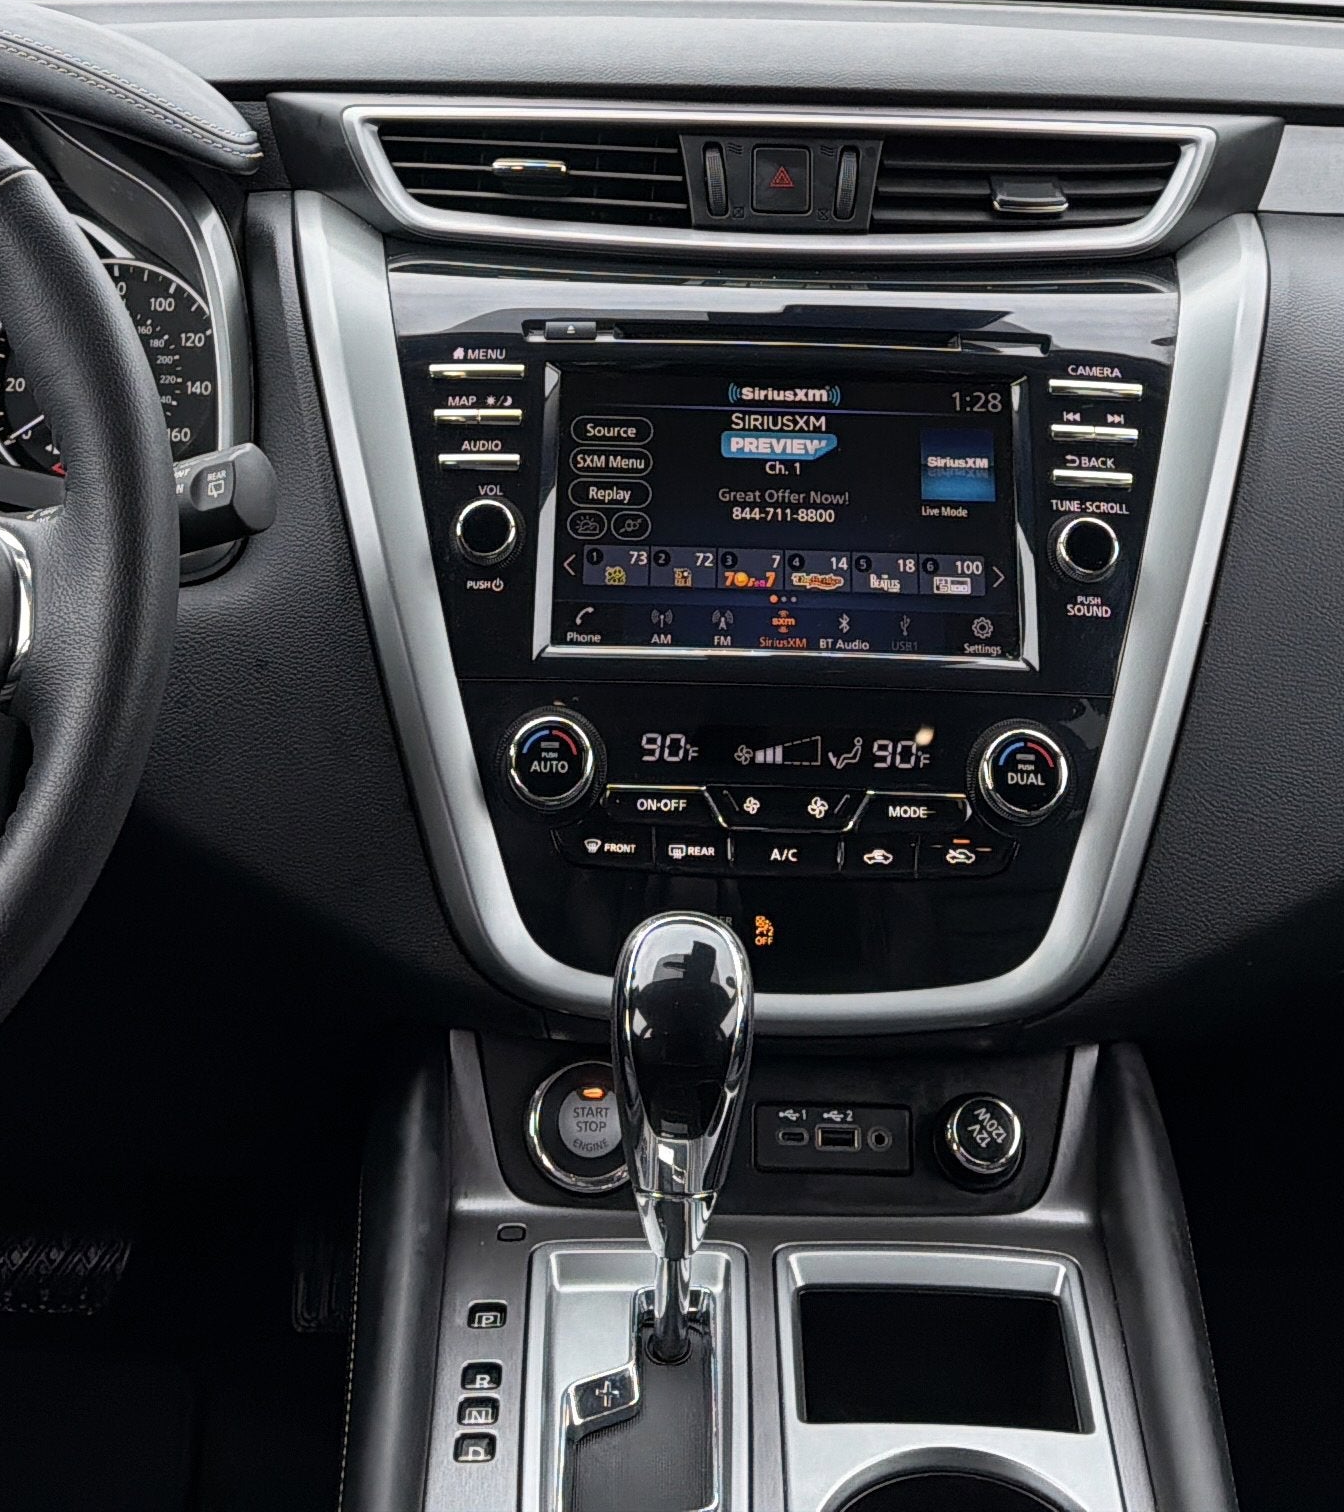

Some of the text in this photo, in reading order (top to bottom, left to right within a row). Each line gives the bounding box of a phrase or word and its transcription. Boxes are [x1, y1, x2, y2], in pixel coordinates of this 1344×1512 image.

[150, 297, 175, 312] 100
[180, 333, 205, 347] 120
[467, 349, 506, 360] MENU
[1068, 365, 1122, 378] CAMERA
[5, 378, 26, 392] 20
[160, 374, 176, 384] 220
[185, 380, 212, 395] 140
[448, 396, 477, 406] MAP
[952, 391, 1003, 412] 1:28
[731, 412, 826, 431] SIRIUSXM
[586, 424, 637, 438] Source
[461, 440, 502, 451] AUDIO
[730, 437, 828, 455] PREVIEW
[576, 454, 645, 469] SXM Menu
[765, 461, 801, 475] Ch. 1
[927, 456, 989, 469] SiriusXM
[1081, 457, 1116, 469] BACK
[207, 469, 227, 481] REAR
[478, 485, 504, 496] VOL
[589, 486, 632, 503] Replay
[718, 489, 849, 505] Great Offer Now!
[732, 507, 835, 523] 844-711-8800
[921, 506, 968, 517] Live Mode
[629, 551, 648, 565] 73
[658, 551, 714, 566] 2 72
[725, 555, 781, 569] 3 7
[792, 557, 848, 571] 4 14
[859, 559, 916, 572] 5 18
[926, 561, 983, 575] 6 100
[467, 581, 491, 590] PUSH
[1077, 595, 1102, 605] PUSH
[1066, 604, 1112, 618] SOUND
[566, 631, 602, 644] Phone
[651, 633, 672, 644] AM
[714, 635, 732, 646] FM
[759, 637, 807, 648] SiriusXM
[819, 638, 870, 650] BT Audio
[963, 642, 1002, 655] Settings
[530, 760, 569, 774] AUTO
[1007, 772, 1046, 786] DUAL
[888, 806, 928, 818] MODE
[604, 843, 636, 853] FRONT
[687, 846, 715, 856] REAR
[770, 849, 798, 862] A/C
[755, 936, 773, 946] OFF
[573, 1107, 610, 1118] START
[801, 1109, 807, 1120] 1
[846, 1110, 853, 1121] 2
[576, 1120, 607, 1133] STOP
[973, 1107, 1007, 1144] 120W
[966, 1124, 991, 1148] 12V
[572, 1138, 610, 1153] ENGINE
[481, 1315, 494, 1326] P
[476, 1374, 490, 1388] R
[471, 1410, 485, 1422] N
[468, 1447, 484, 1460] D
